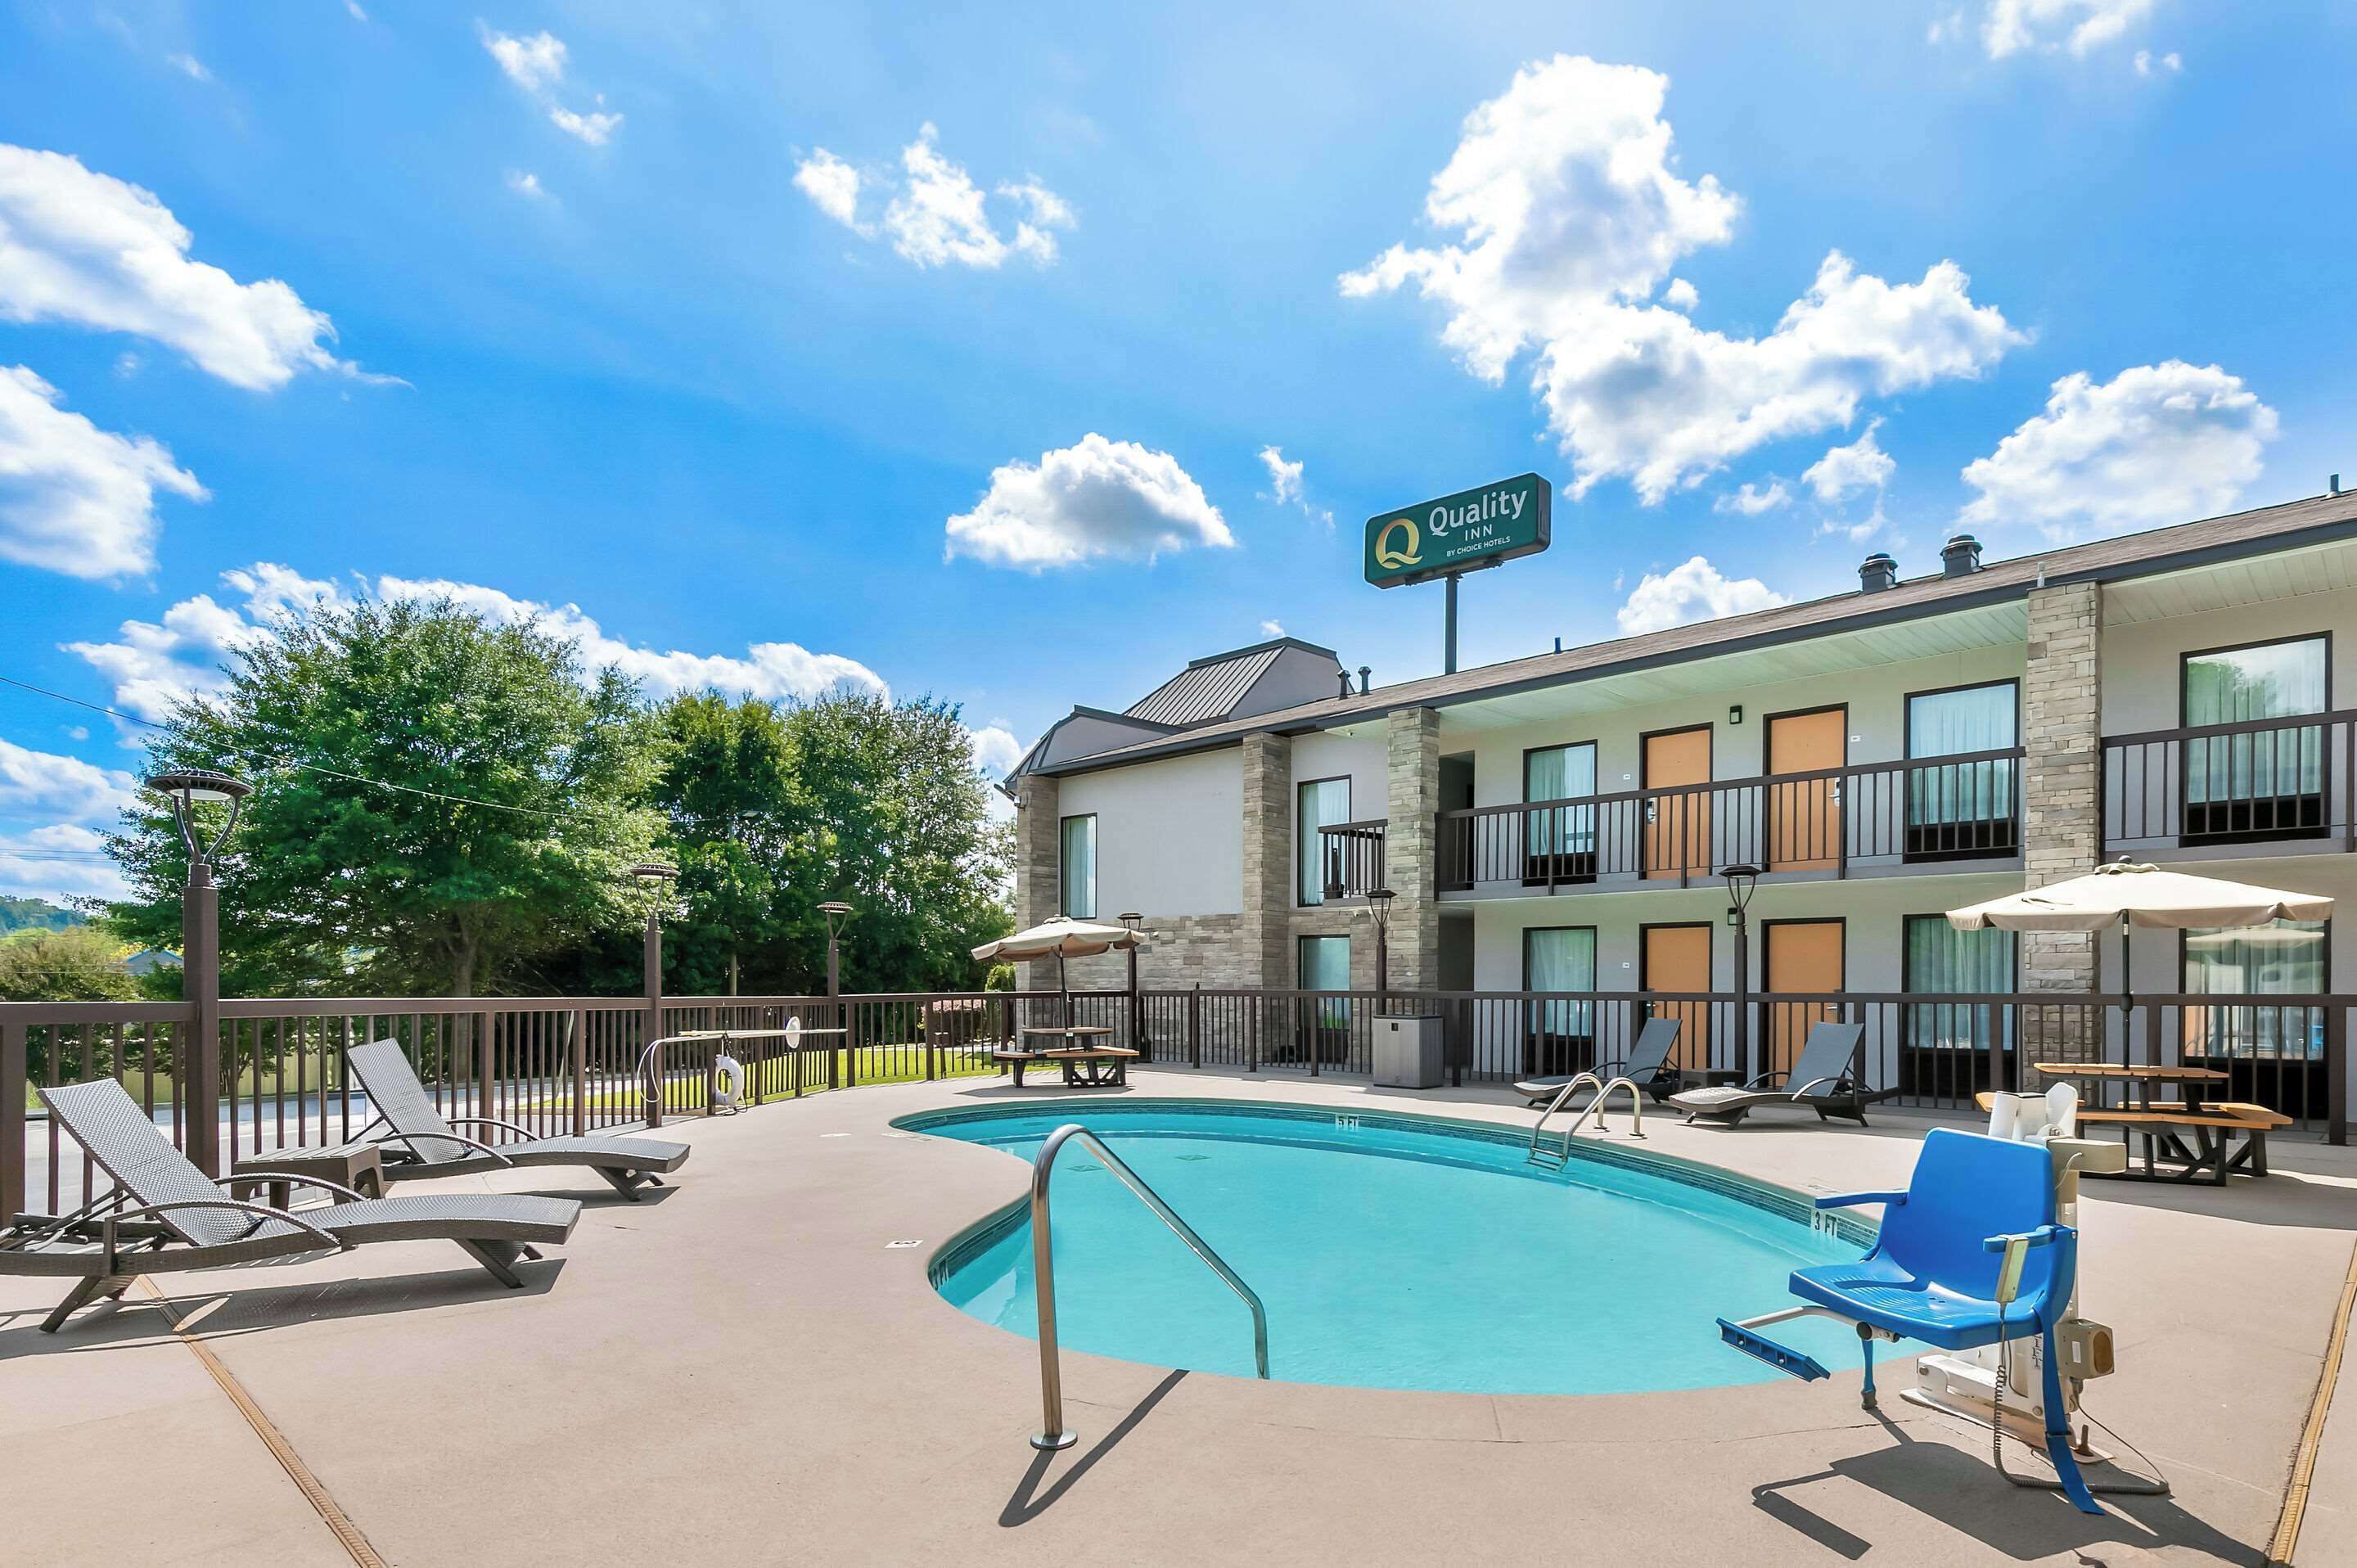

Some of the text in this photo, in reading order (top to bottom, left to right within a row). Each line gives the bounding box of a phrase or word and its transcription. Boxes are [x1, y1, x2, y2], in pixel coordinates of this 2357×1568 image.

[1429, 490, 1527, 537] Quality
[1465, 524, 1494, 541] INN
[1375, 518, 1424, 569] Q
[1457, 543, 1482, 554] CHOICE
[1484, 536, 1511, 548] HOTELS
[1338, 1115, 1358, 1127] 5 FT
[1814, 1211, 1836, 1236] 3 FT
